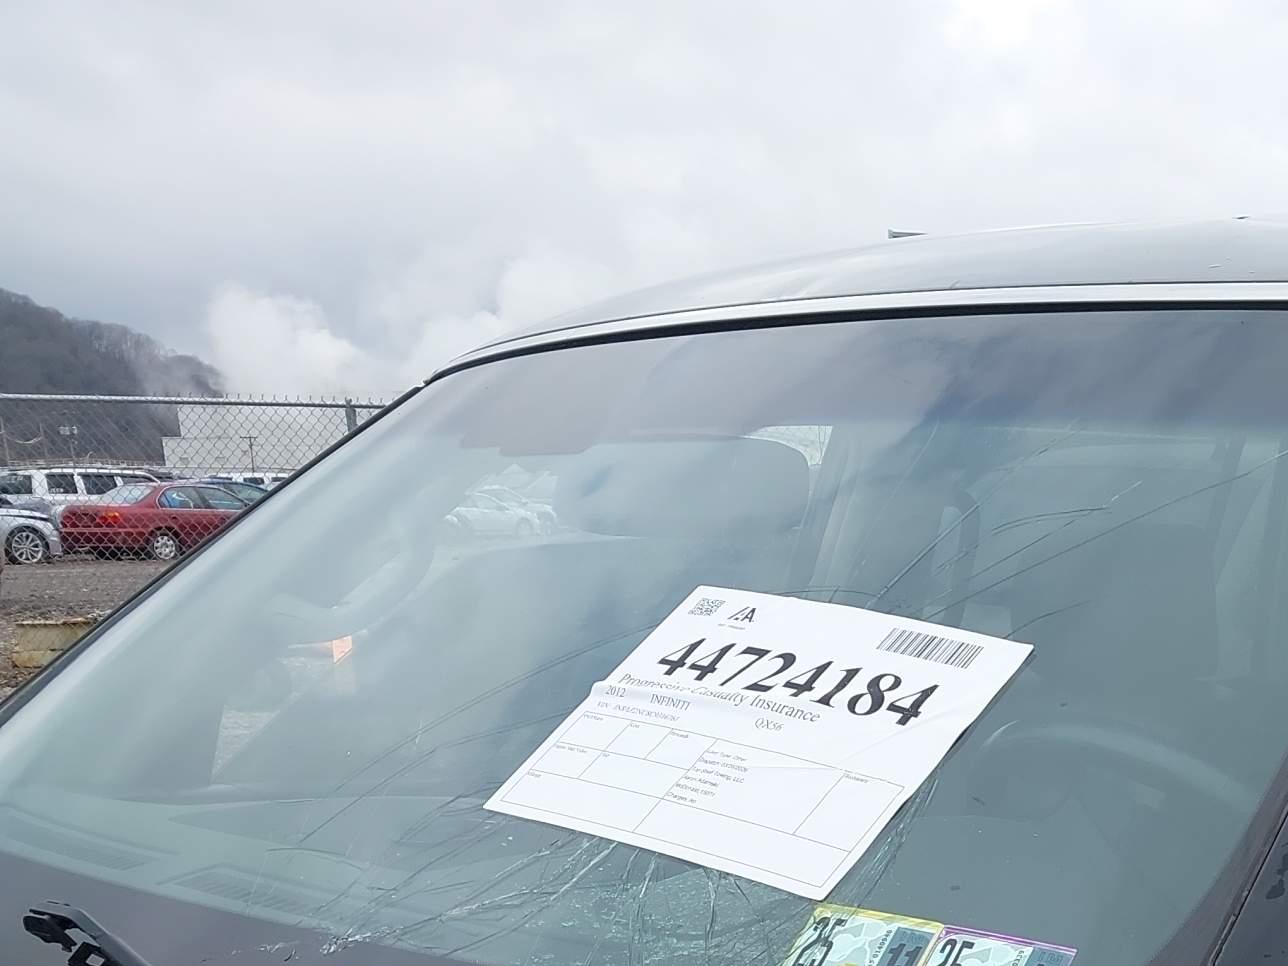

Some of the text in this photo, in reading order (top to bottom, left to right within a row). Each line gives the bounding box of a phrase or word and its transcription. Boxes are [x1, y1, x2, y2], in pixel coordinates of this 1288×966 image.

[605, 685, 690, 711] 2012 INFINITI
[657, 637, 940, 727] 44724184
[690, 685, 748, 706] Casualty
[749, 693, 822, 723] Insurance
[754, 717, 785, 733] QX56
